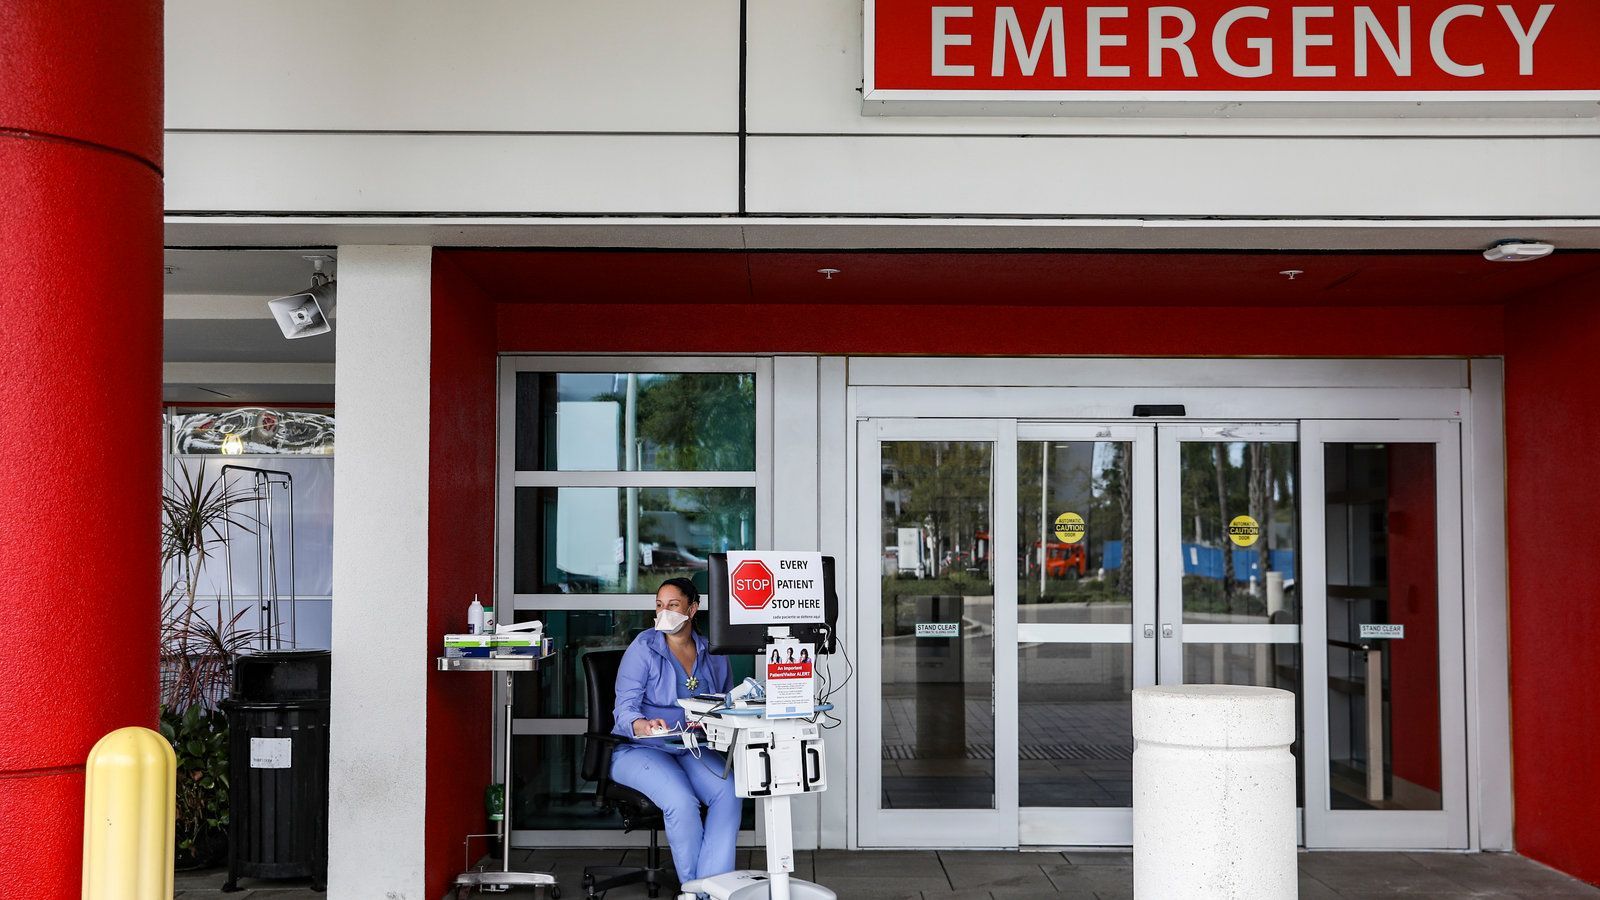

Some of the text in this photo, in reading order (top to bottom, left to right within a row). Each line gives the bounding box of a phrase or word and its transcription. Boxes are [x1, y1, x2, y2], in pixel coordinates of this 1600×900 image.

[930, 4, 1555, 78] EMERGENCY
[1055, 524, 1085, 532] CAUTION
[1230, 527, 1259, 535] CAUTION
[780, 560, 808, 570] EVERY
[736, 578, 770, 591] STOP
[777, 579, 814, 589] PATIENT
[771, 599, 821, 609] STOP HERE
